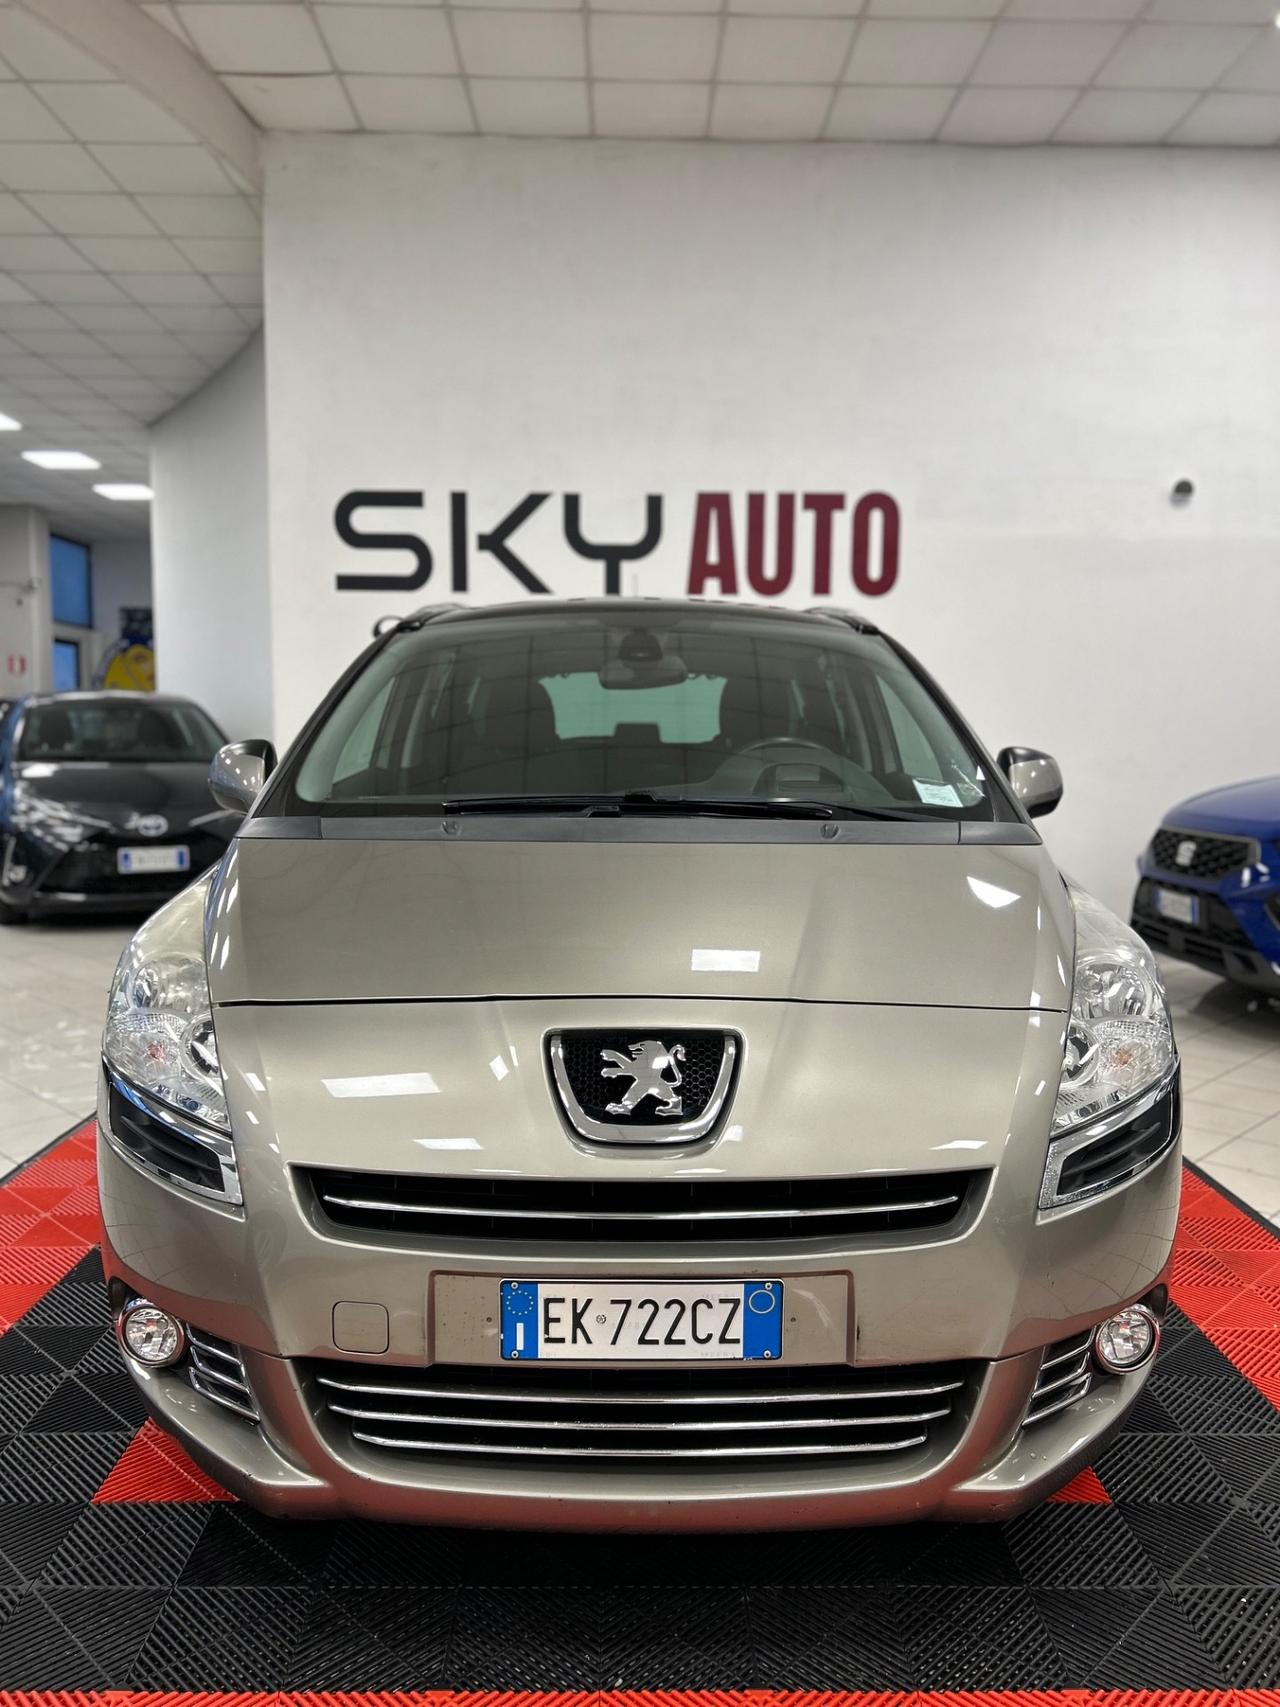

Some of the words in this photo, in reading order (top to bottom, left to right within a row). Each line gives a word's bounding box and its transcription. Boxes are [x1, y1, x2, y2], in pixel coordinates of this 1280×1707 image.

[333, 490, 662, 596] SKY
[686, 491, 901, 597] AUTO
[516, 1322, 524, 1350] I
[543, 1297, 593, 1344] EK
[610, 1298, 741, 1345] 722CZ
